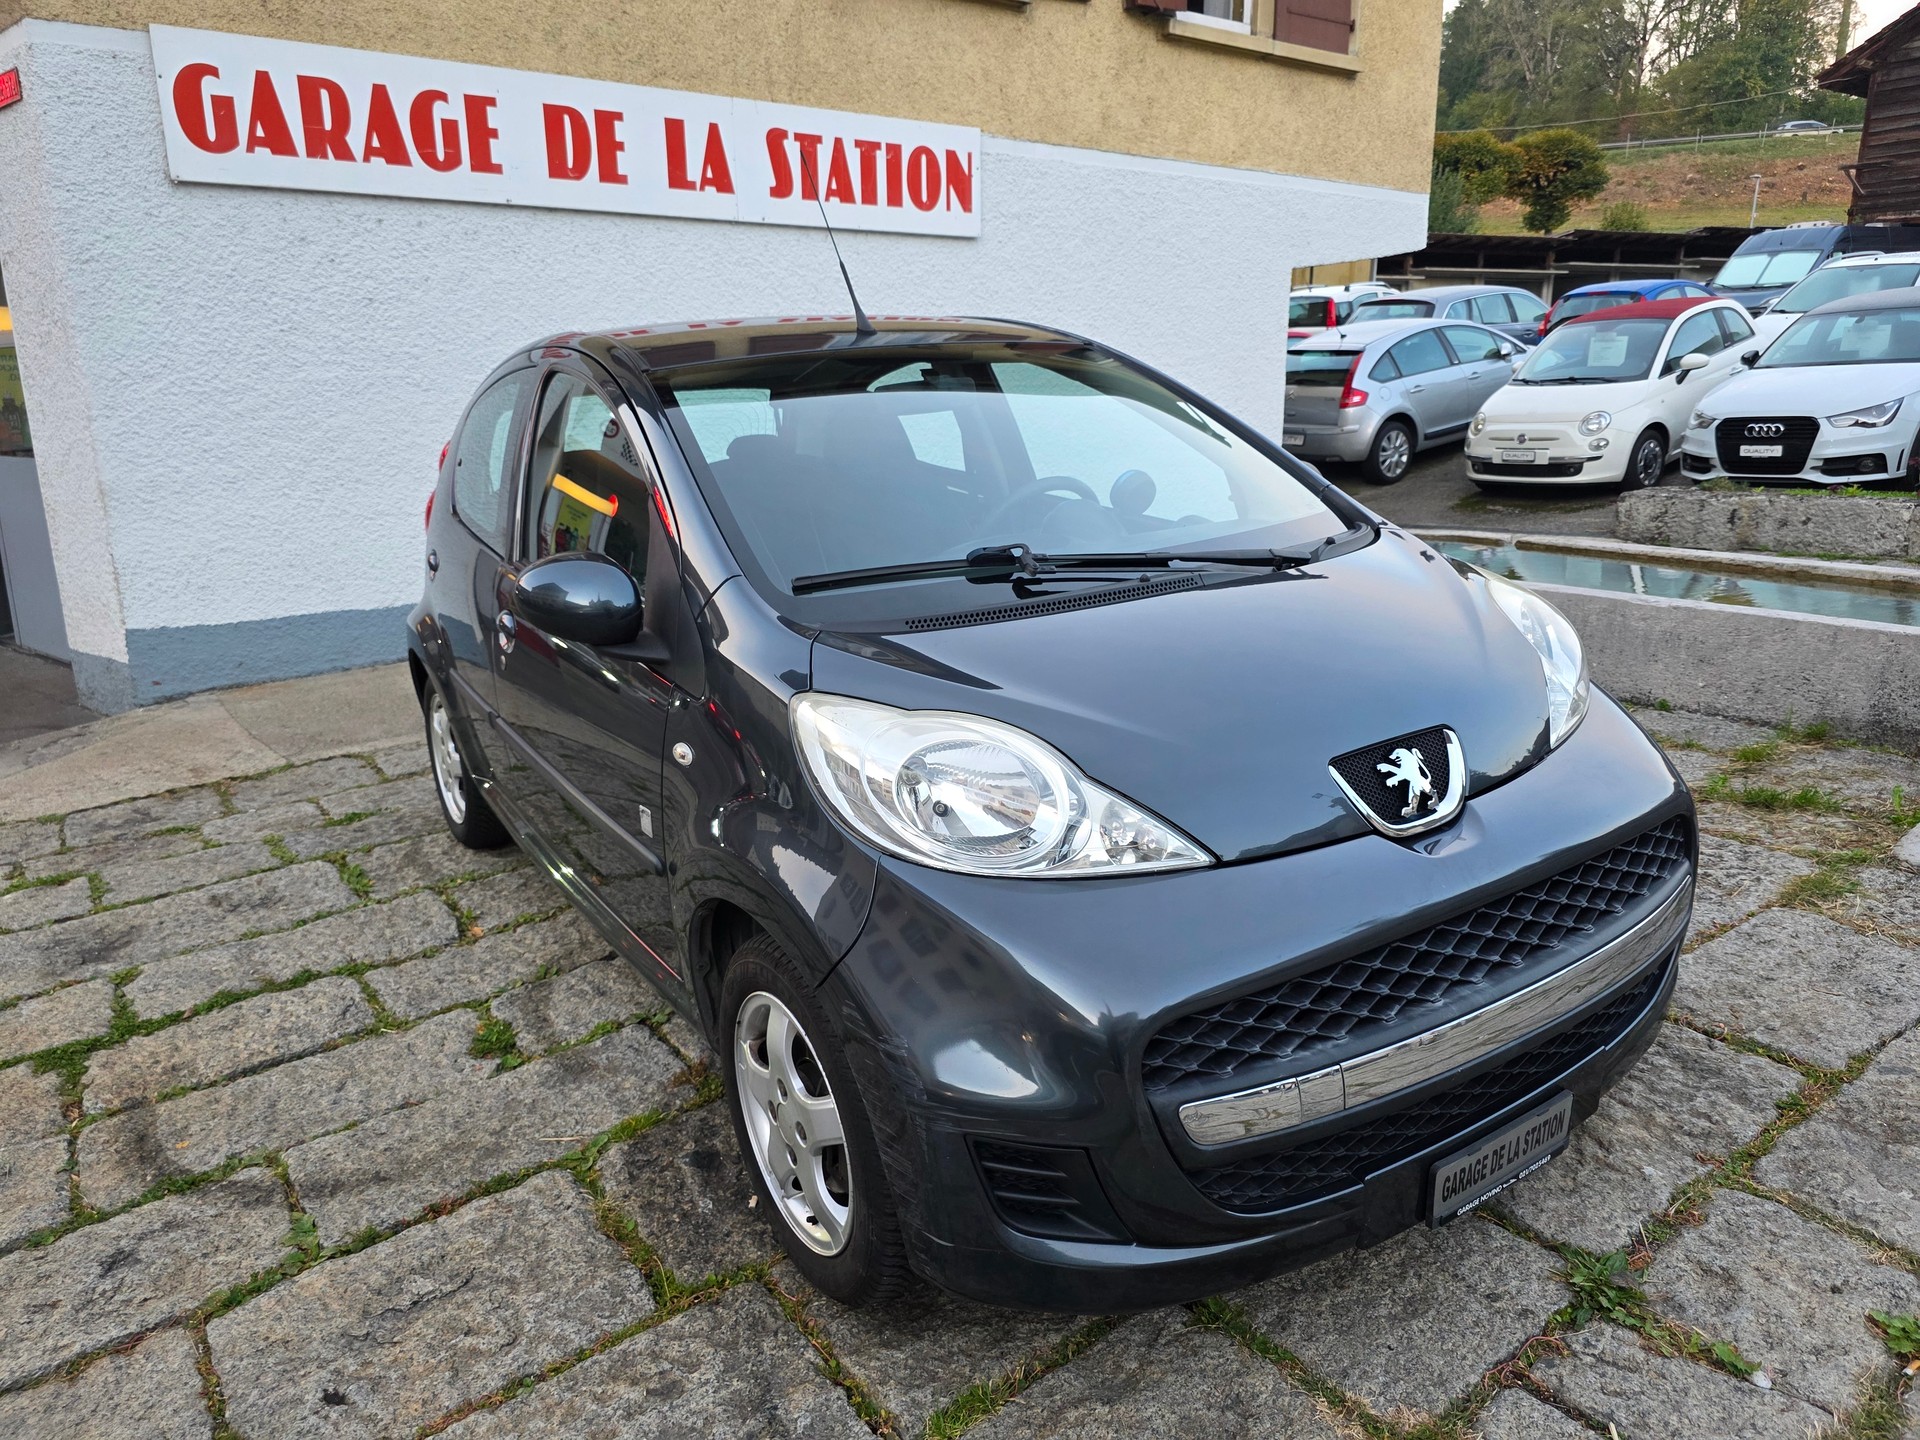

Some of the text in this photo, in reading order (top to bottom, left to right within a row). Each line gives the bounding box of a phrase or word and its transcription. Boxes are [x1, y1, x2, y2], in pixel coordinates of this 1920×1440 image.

[172, 62, 973, 214] GARAGE DE LA STATION
[1441, 1109, 1566, 1203] GARAGE DE LA STATION
[1457, 1197, 1480, 1216] GARAGE
